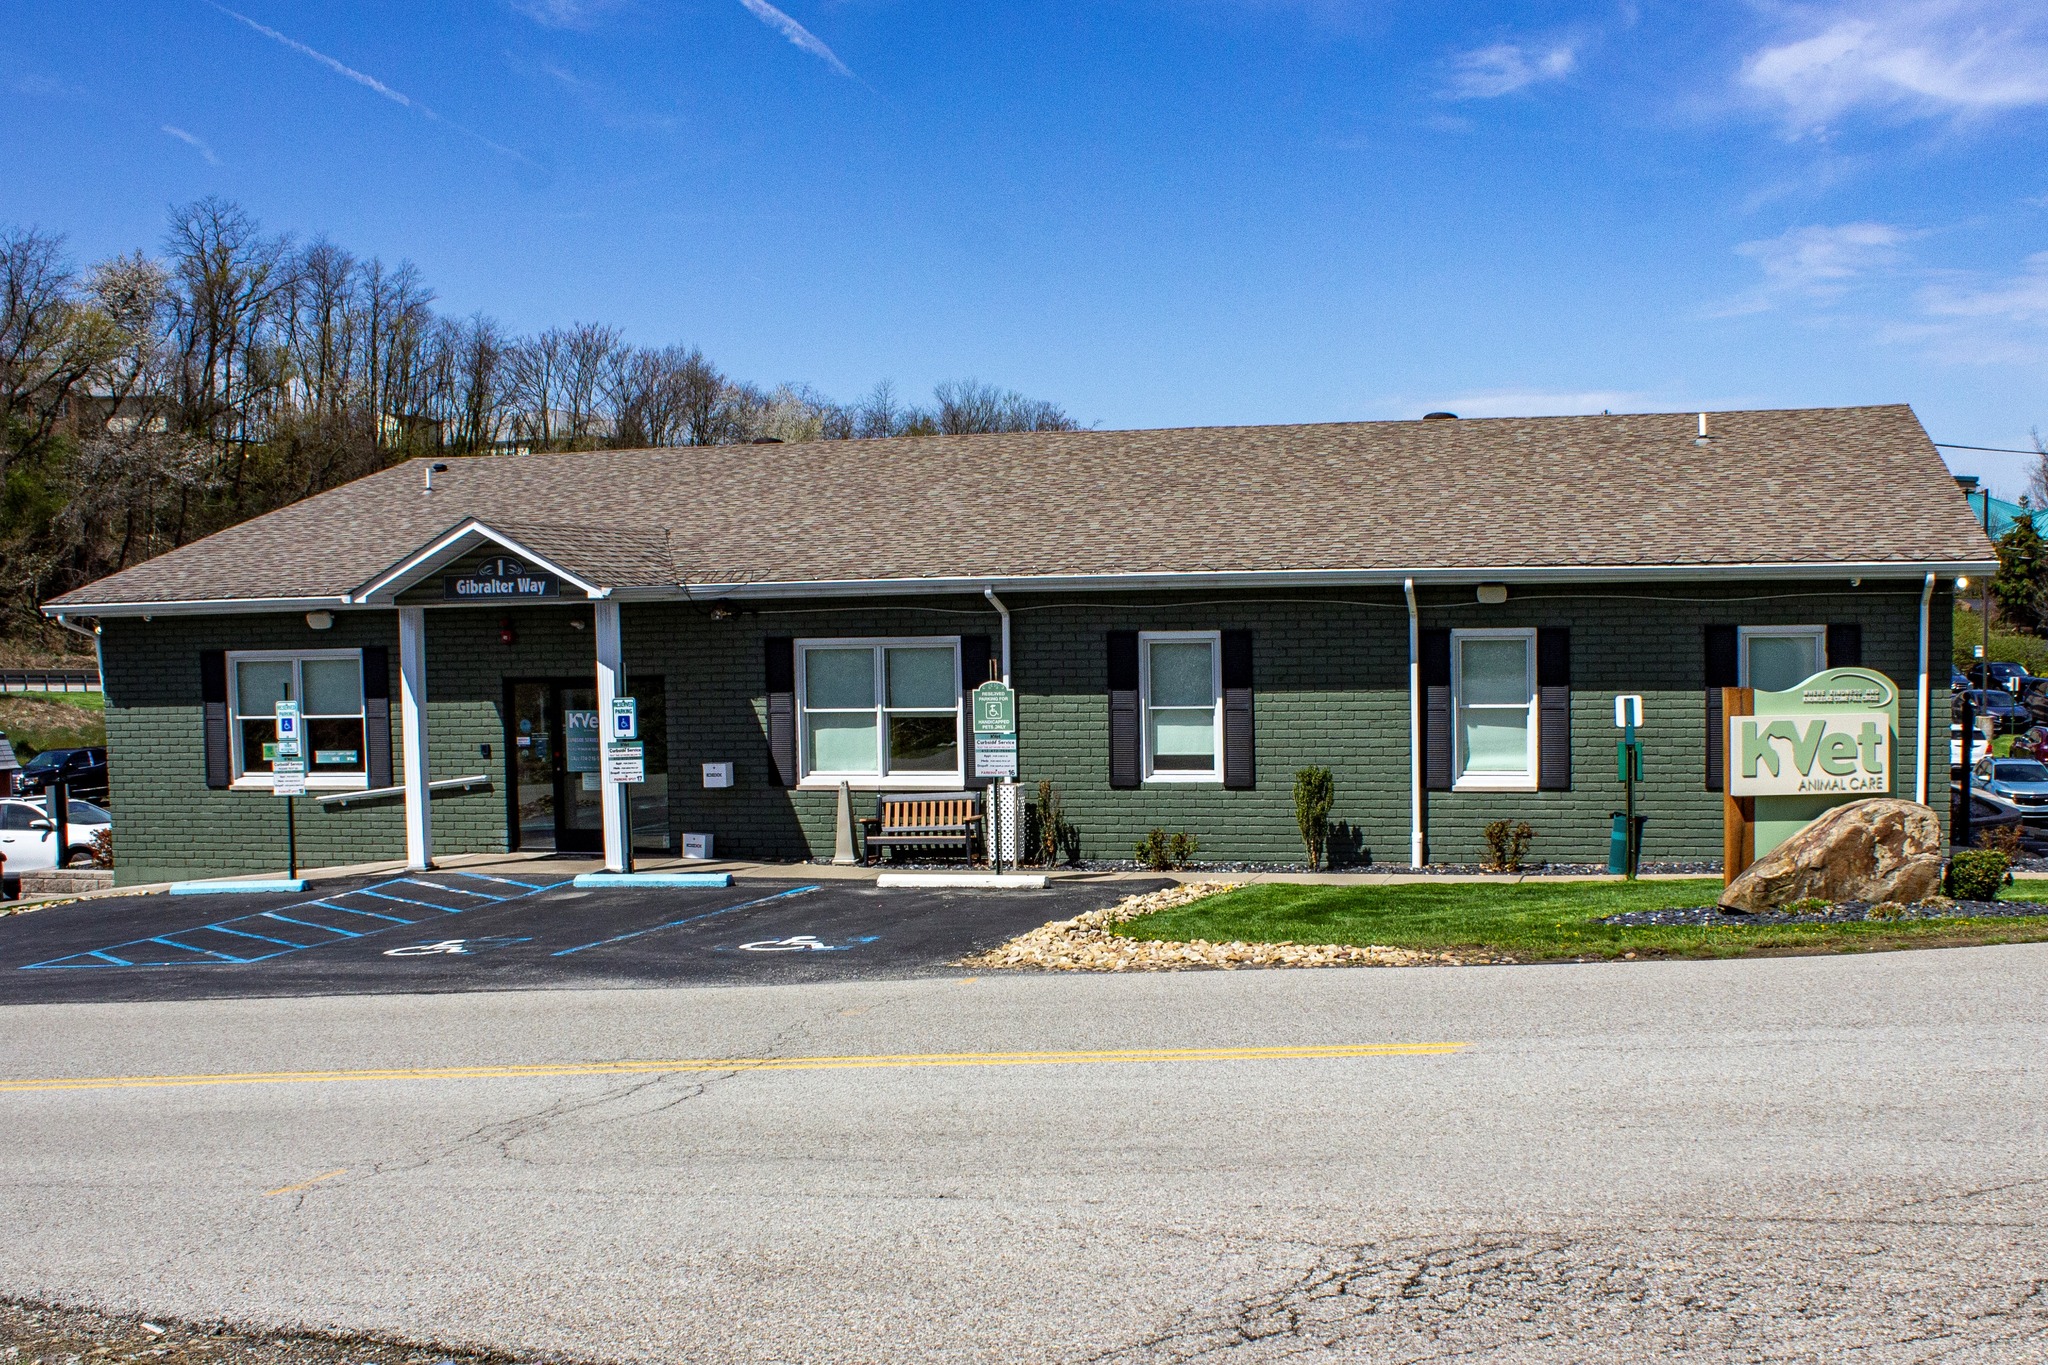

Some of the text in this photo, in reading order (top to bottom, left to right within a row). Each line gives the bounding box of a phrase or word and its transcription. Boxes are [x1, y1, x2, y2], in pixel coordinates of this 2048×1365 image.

[456, 577, 546, 595] Gibralter Way
[568, 713, 599, 728] KVe
[1742, 720, 1882, 777] KVet
[1798, 777, 1883, 792] ANIMAL CARE
